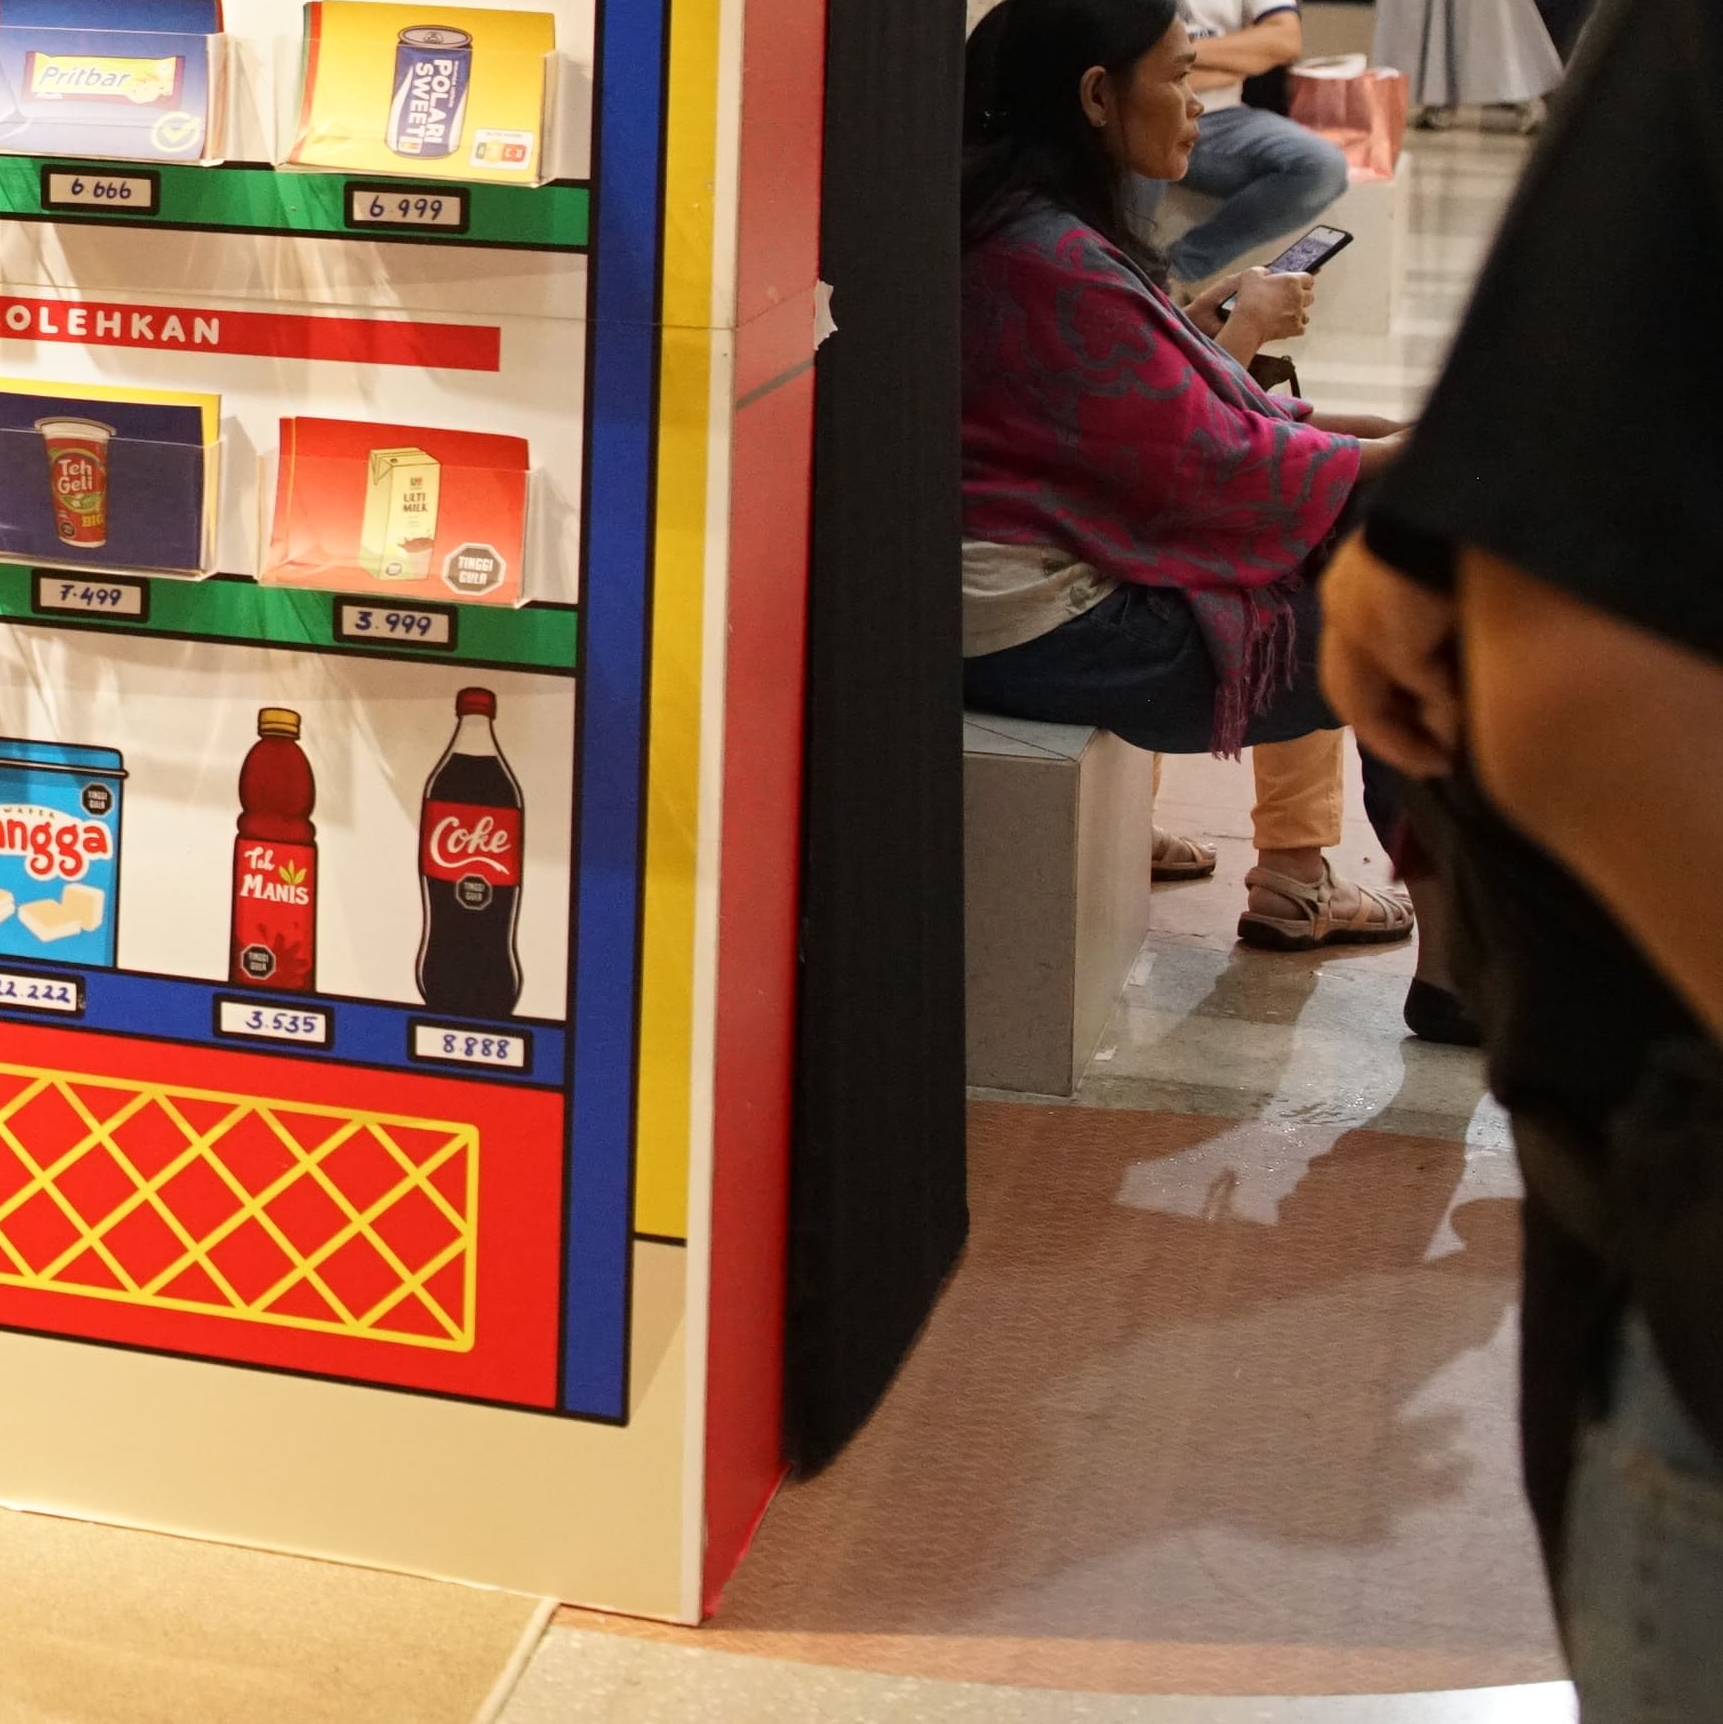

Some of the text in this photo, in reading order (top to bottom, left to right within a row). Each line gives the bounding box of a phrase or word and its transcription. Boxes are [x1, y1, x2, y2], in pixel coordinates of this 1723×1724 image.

[38, 66, 131, 88] Pritbar
[406, 62, 434, 139] SWEET
[424, 59, 453, 144] POLARI
[58, 459, 93, 477] Teh
[58, 475, 93, 494] Geli
[403, 503, 428, 513] MILK
[458, 556, 494, 572] TINGGI
[459, 571, 488, 585] GULA
[60, 584, 123, 607] 7.499
[355, 611, 432, 636] 3.999
[430, 816, 512, 869] Coke
[244, 846, 275, 871] Teh
[246, 1011, 318, 1033] 3.535
[443, 1034, 511, 1059] 8.888
